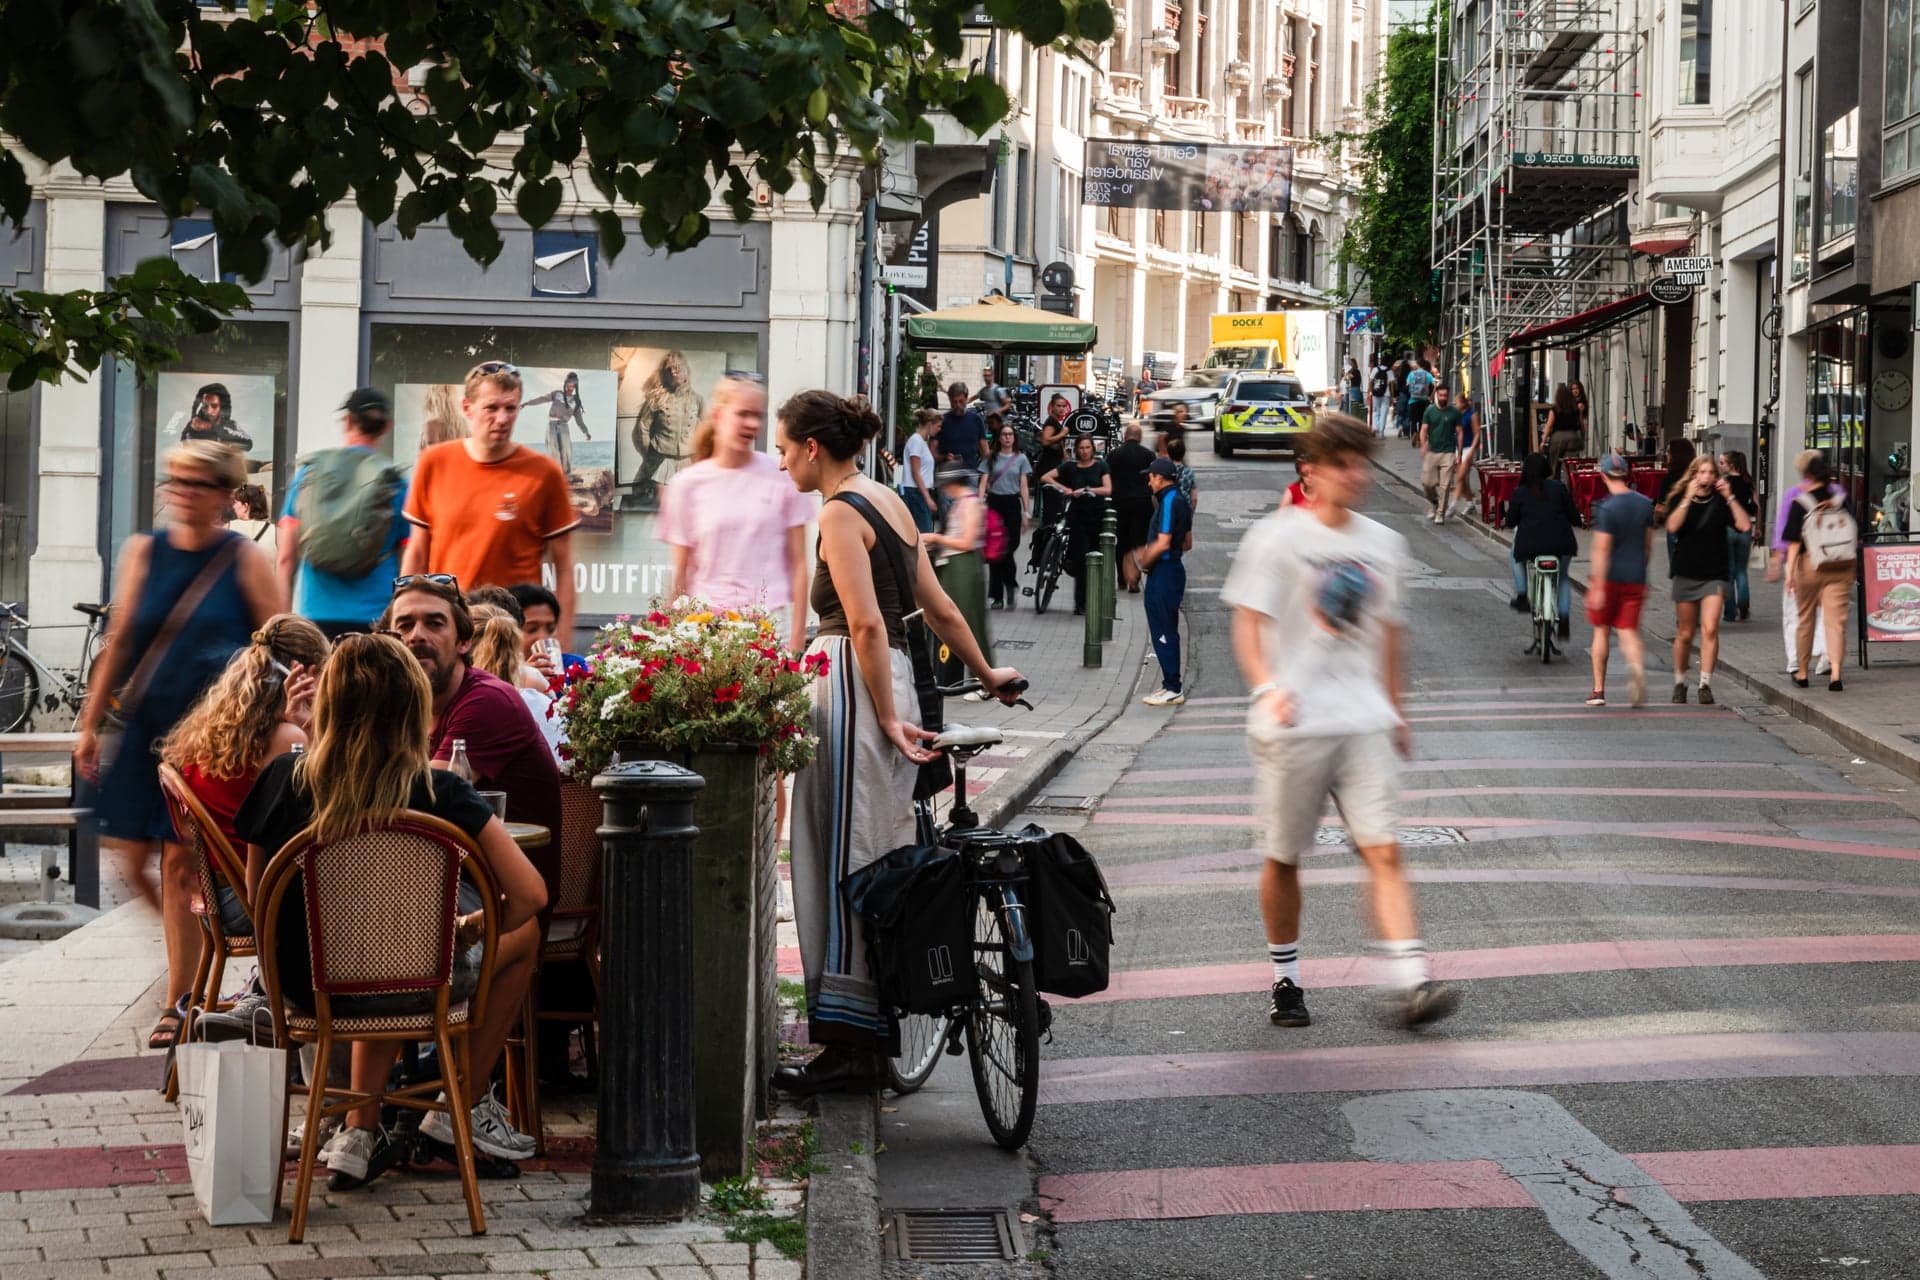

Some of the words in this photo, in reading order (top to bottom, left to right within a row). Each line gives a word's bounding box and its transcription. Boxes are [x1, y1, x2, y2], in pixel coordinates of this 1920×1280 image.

[1543, 154, 1574, 163] DECO
[1582, 155, 1618, 165] 050/22
[1620, 156, 1634, 165] 04
[908, 220, 929, 262] PLU
[1667, 258, 1712, 270] AMERICA
[1675, 272, 1704, 285] TODAY
